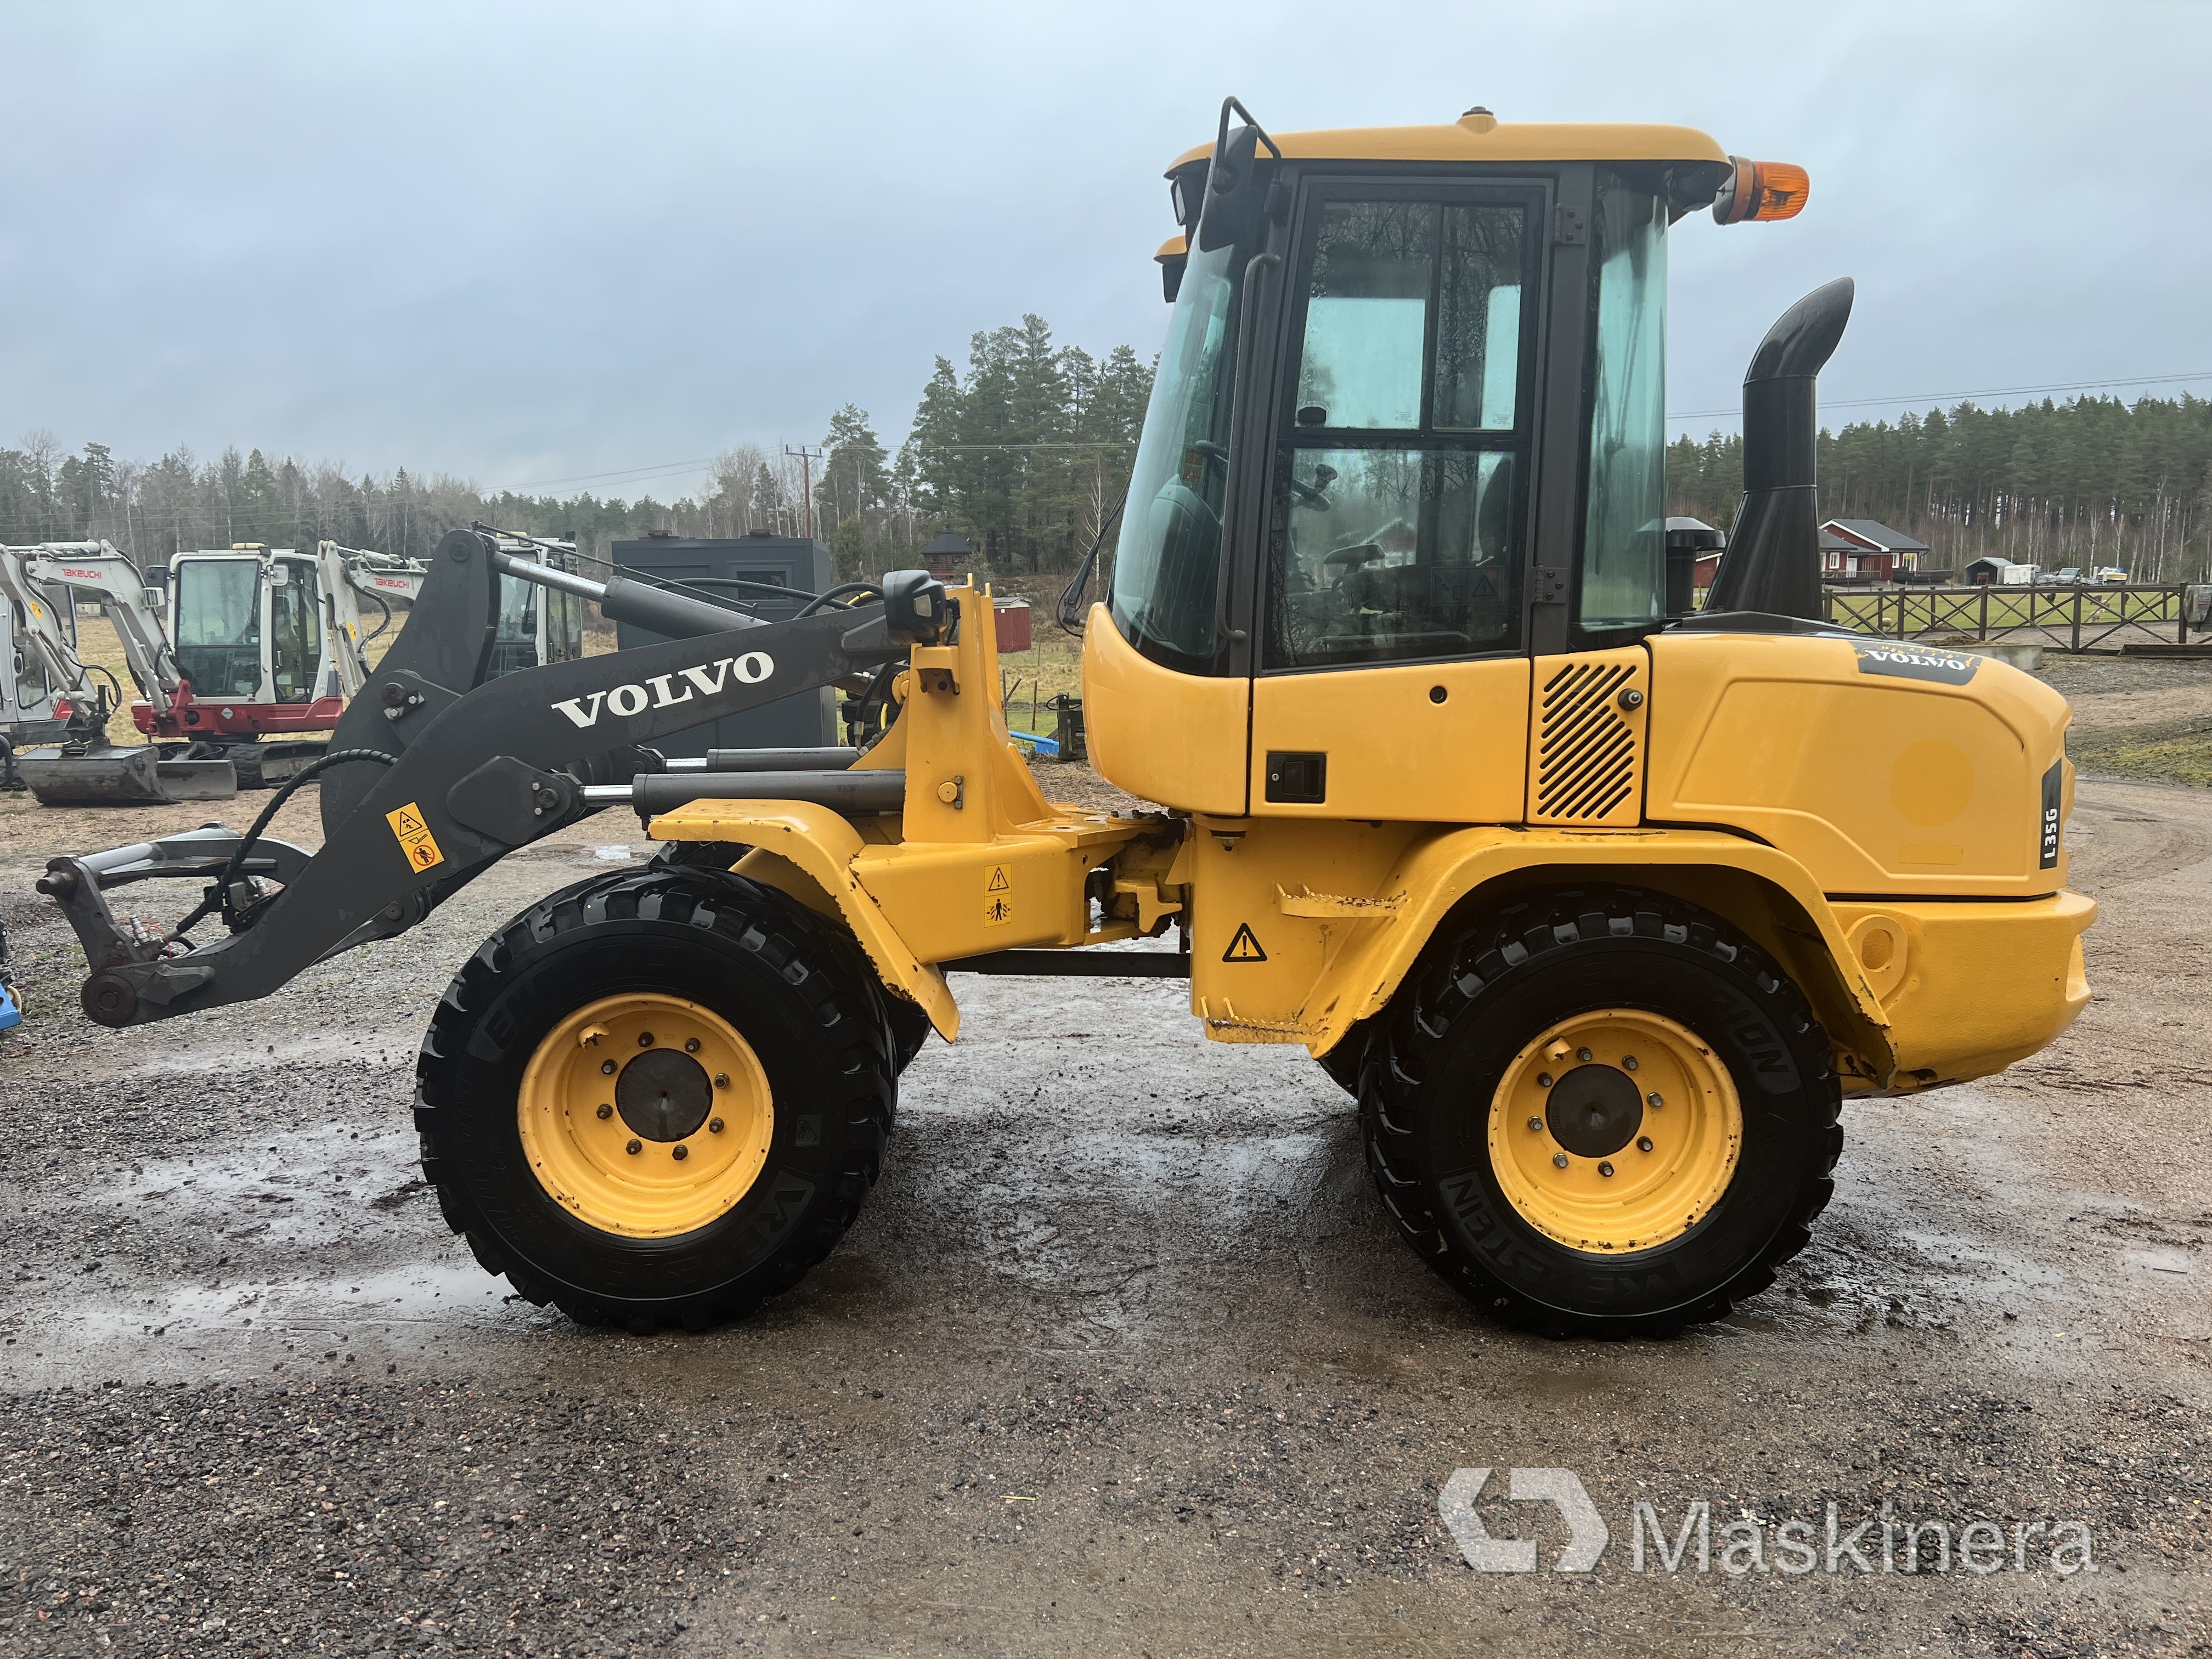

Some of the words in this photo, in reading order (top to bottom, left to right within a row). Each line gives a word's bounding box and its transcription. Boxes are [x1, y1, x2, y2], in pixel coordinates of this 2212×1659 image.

[61, 568, 101, 579] TAKEUCHI
[374, 578, 410, 589] TAKEUCHI
[1865, 650, 1966, 670] VOLVO
[551, 651, 774, 728] VOLVO
[2044, 808, 2057, 859] L35G
